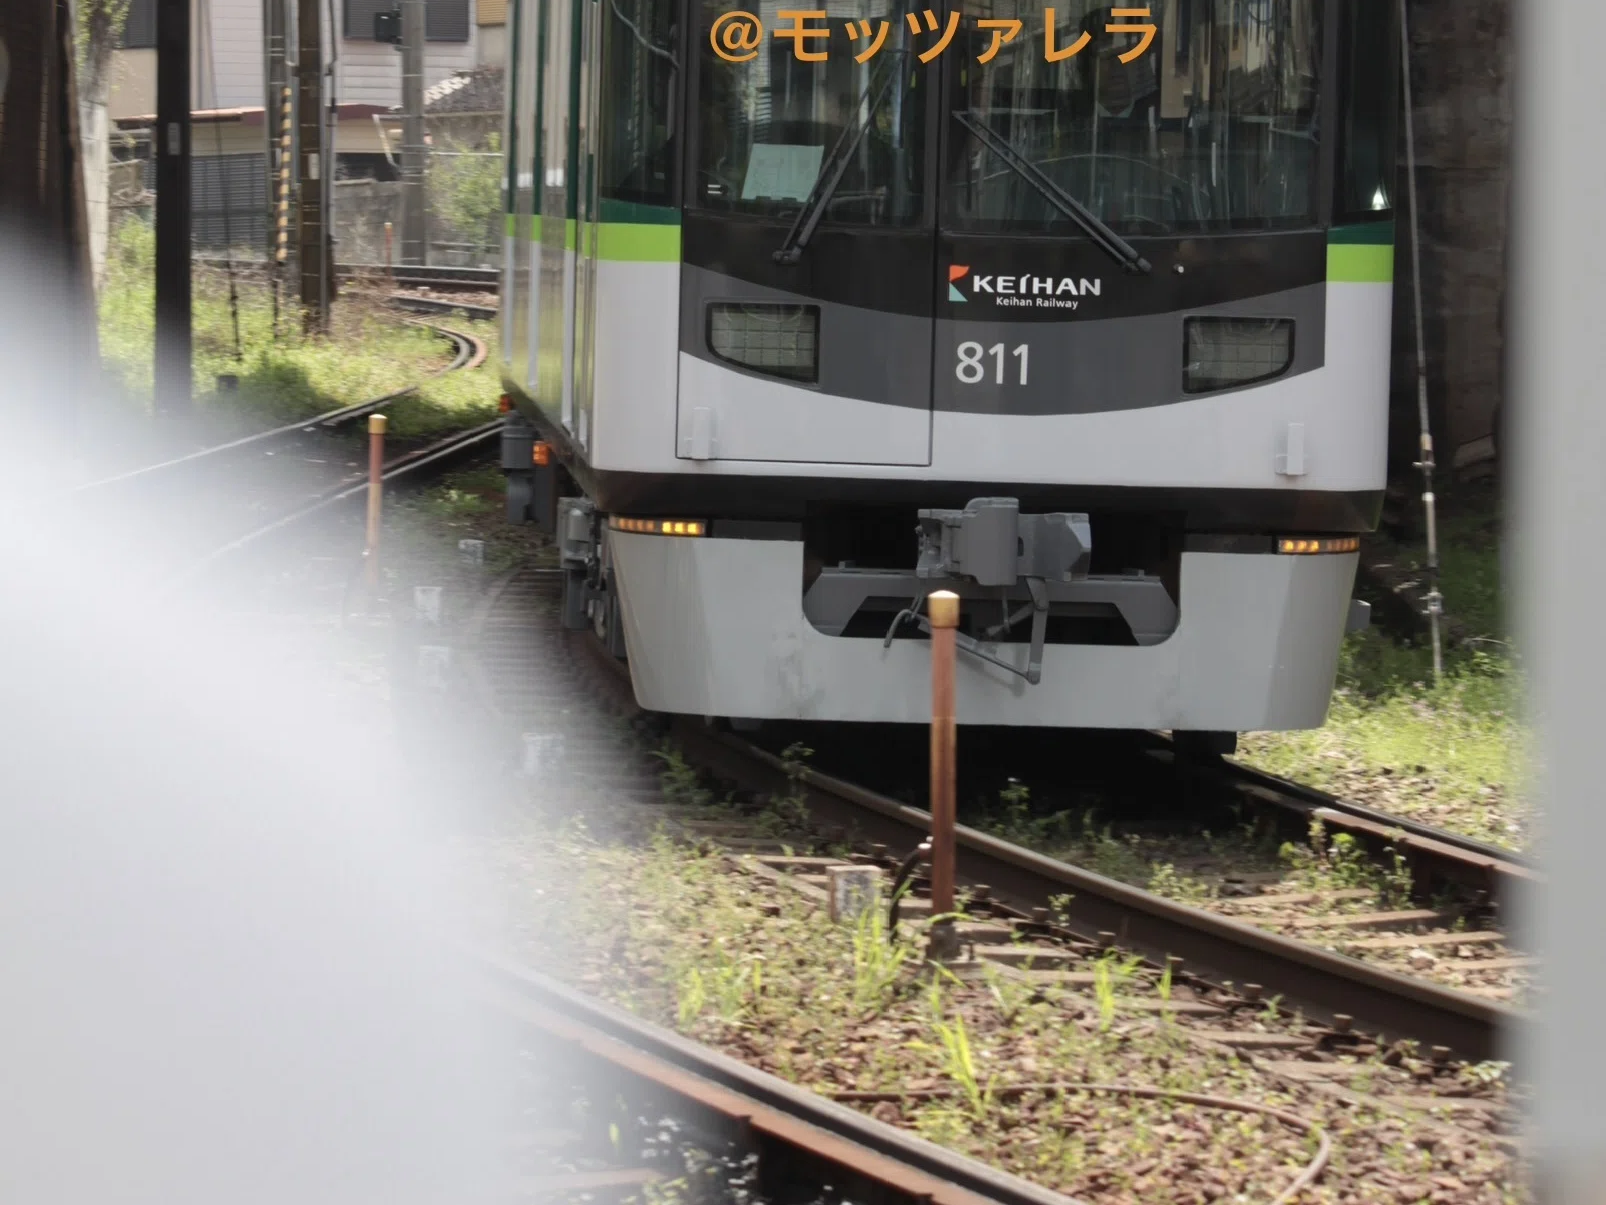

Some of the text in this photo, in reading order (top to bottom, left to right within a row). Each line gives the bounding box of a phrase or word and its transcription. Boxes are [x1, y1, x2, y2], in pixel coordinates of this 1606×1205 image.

[972, 273, 1101, 297] KEIHAN
[996, 296, 1079, 311] Keihan Railway
[955, 340, 1029, 386] 811
